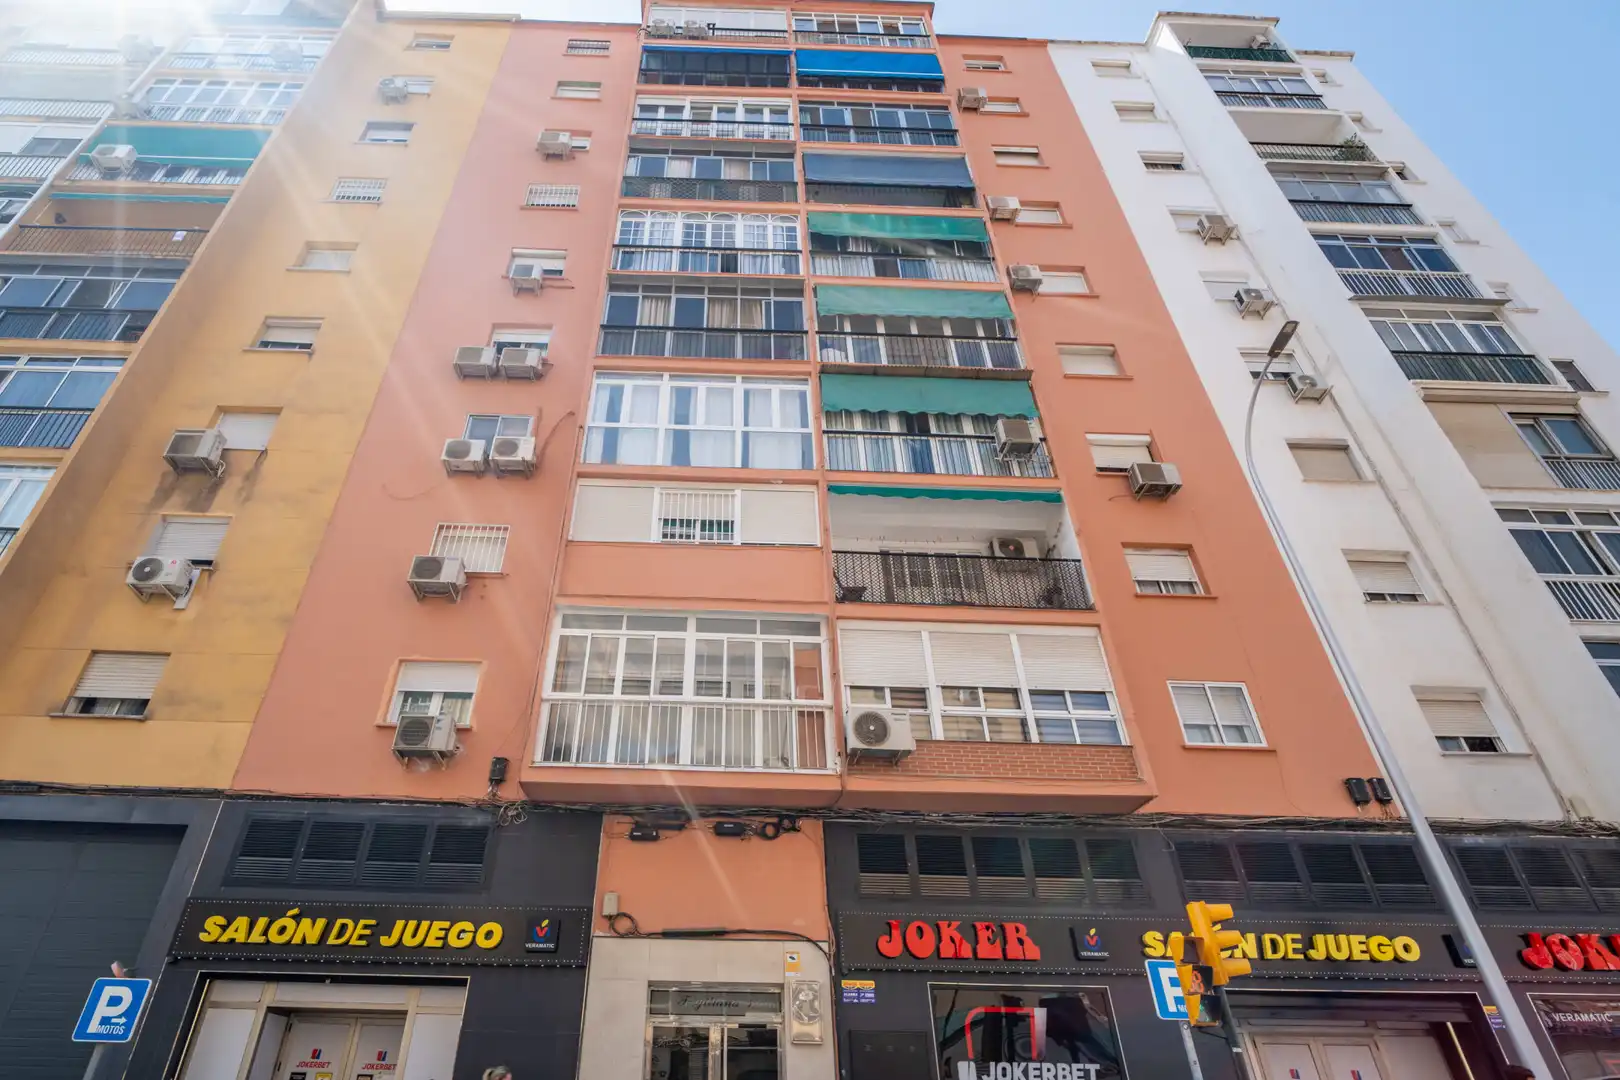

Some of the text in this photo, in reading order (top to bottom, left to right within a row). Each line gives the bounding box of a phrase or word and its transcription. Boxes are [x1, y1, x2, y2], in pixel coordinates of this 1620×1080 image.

[199, 907, 503, 949] SALÓN DE JUEGO
[877, 920, 1041, 960] JOKER
[1262, 933, 1304, 960] DE
[1306, 933, 1421, 962] JUEGO
[86, 986, 133, 1034] P
[1552, 1013, 1613, 1023] VERAMATIC
[96, 1025, 126, 1035] MOTOS
[296, 1061, 331, 1069] JOKERBET
[362, 1063, 397, 1071] JOKERBET
[982, 1060, 1101, 1080] JOKERBET
